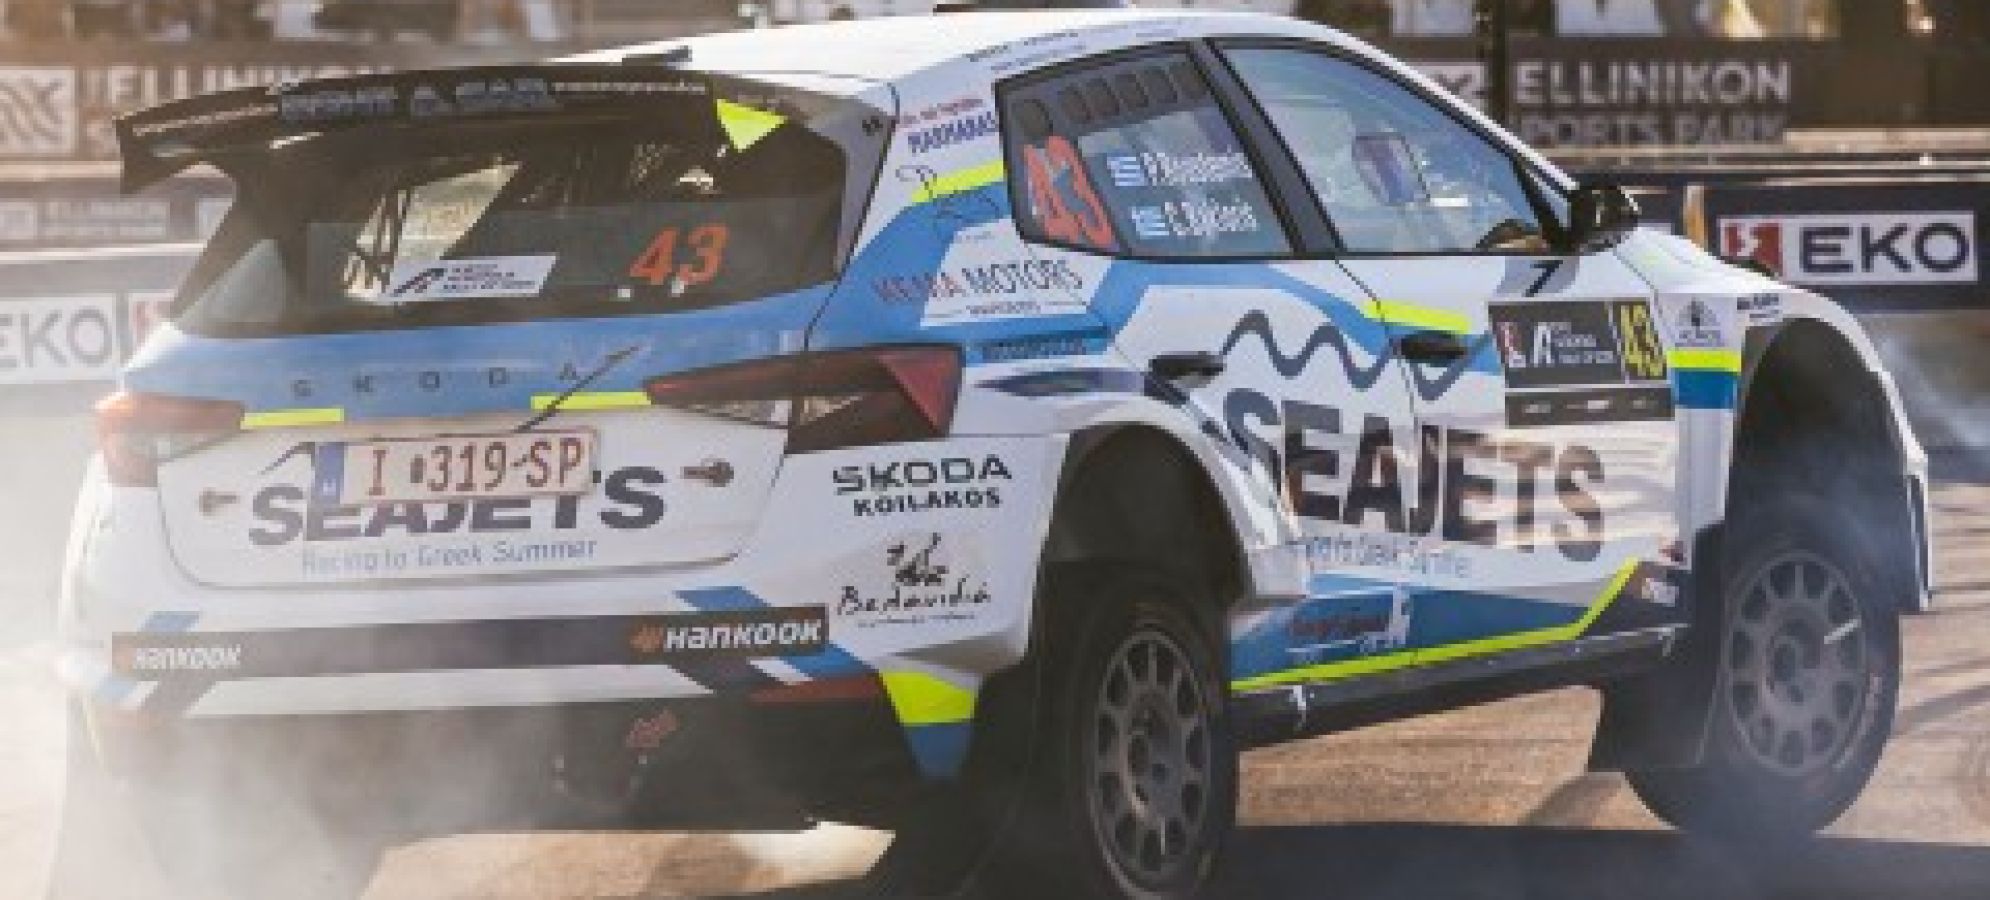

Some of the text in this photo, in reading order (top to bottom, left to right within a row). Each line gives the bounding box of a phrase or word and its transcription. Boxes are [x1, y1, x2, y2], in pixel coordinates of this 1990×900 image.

[1516, 61, 1792, 103] ELLINIKON
[1023, 135, 1118, 249] 43
[629, 223, 730, 286] 43
[1801, 223, 1970, 273] EKO
[961, 258, 1084, 297] MOTORS
[1620, 304, 1666, 377] 43
[832, 453, 1013, 495] SKODA
[1221, 387, 1606, 562] SEAJETS
[853, 486, 1003, 517] KOILAKOS
[417, 544, 484, 568] Greek
[491, 538, 599, 564] Summer
